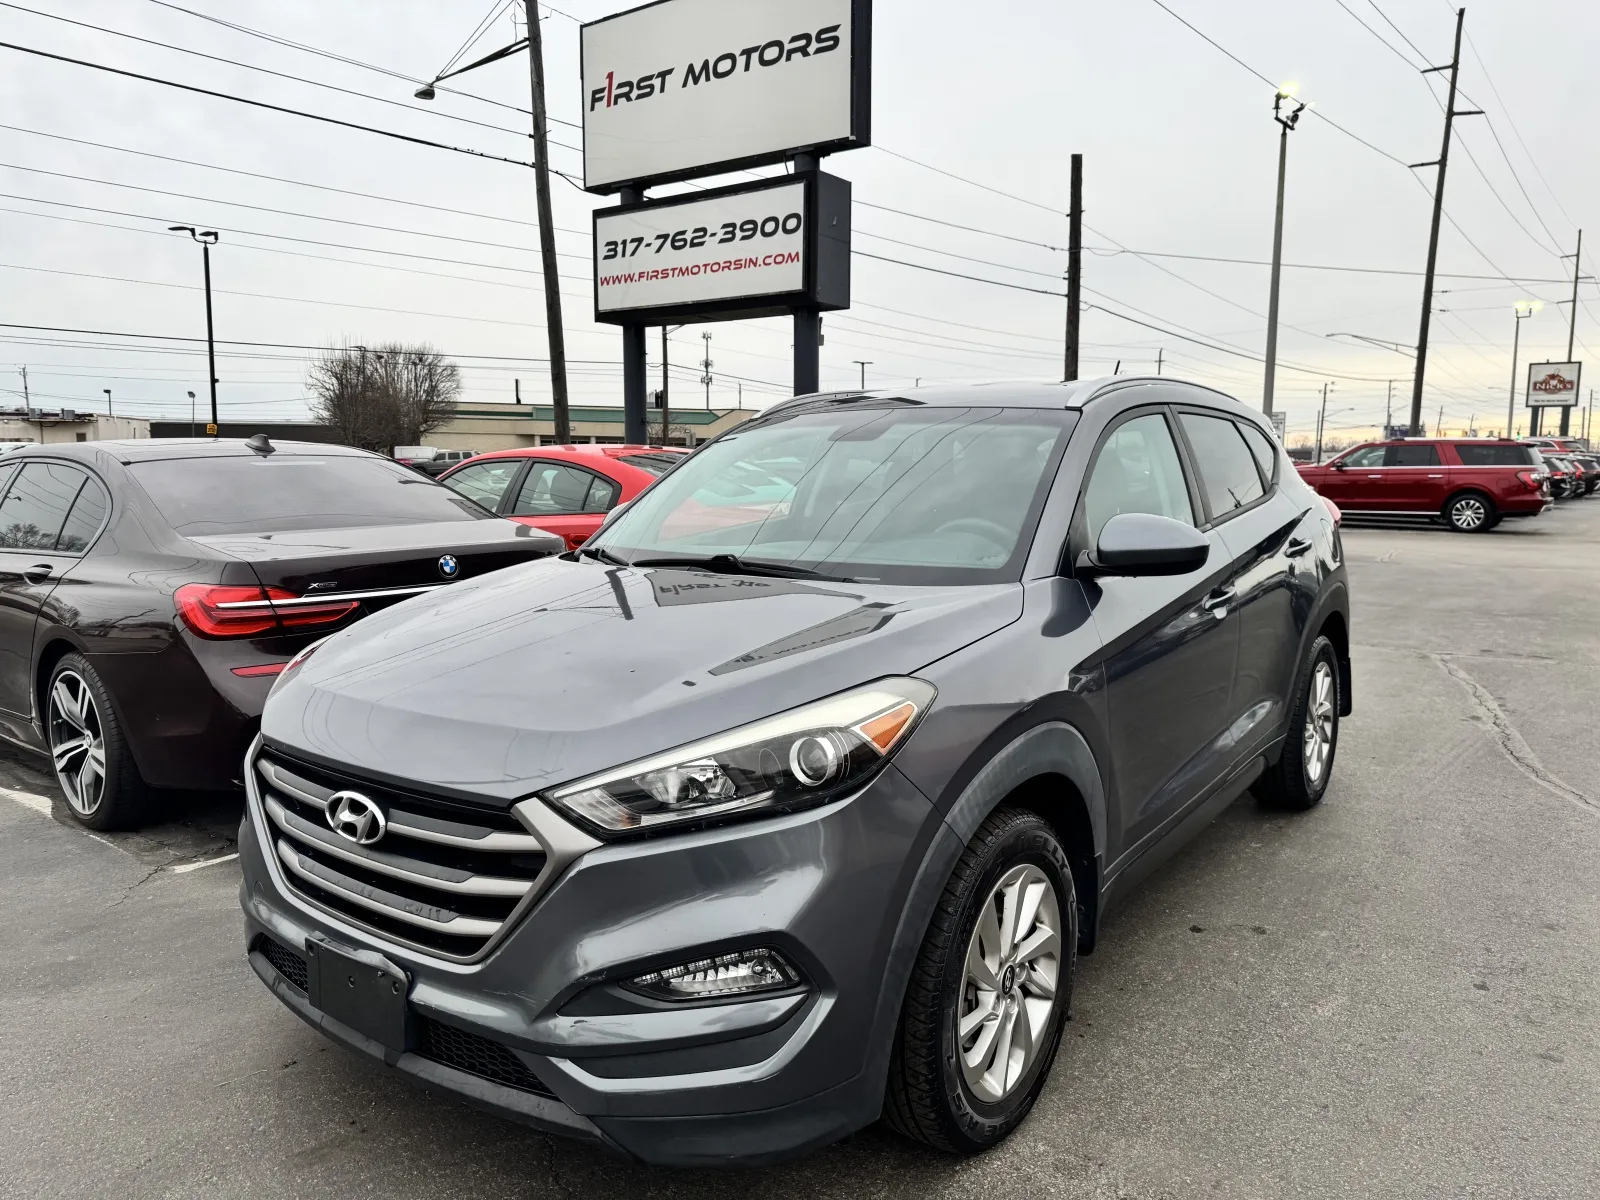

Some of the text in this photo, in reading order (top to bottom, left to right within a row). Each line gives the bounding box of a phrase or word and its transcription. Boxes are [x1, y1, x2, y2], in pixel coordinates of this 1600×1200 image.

[682, 24, 842, 88] MOTORS
[602, 213, 802, 260] 317-762-3900
[600, 251, 800, 286] WWW.FIRSTMOTORSIN.COM
